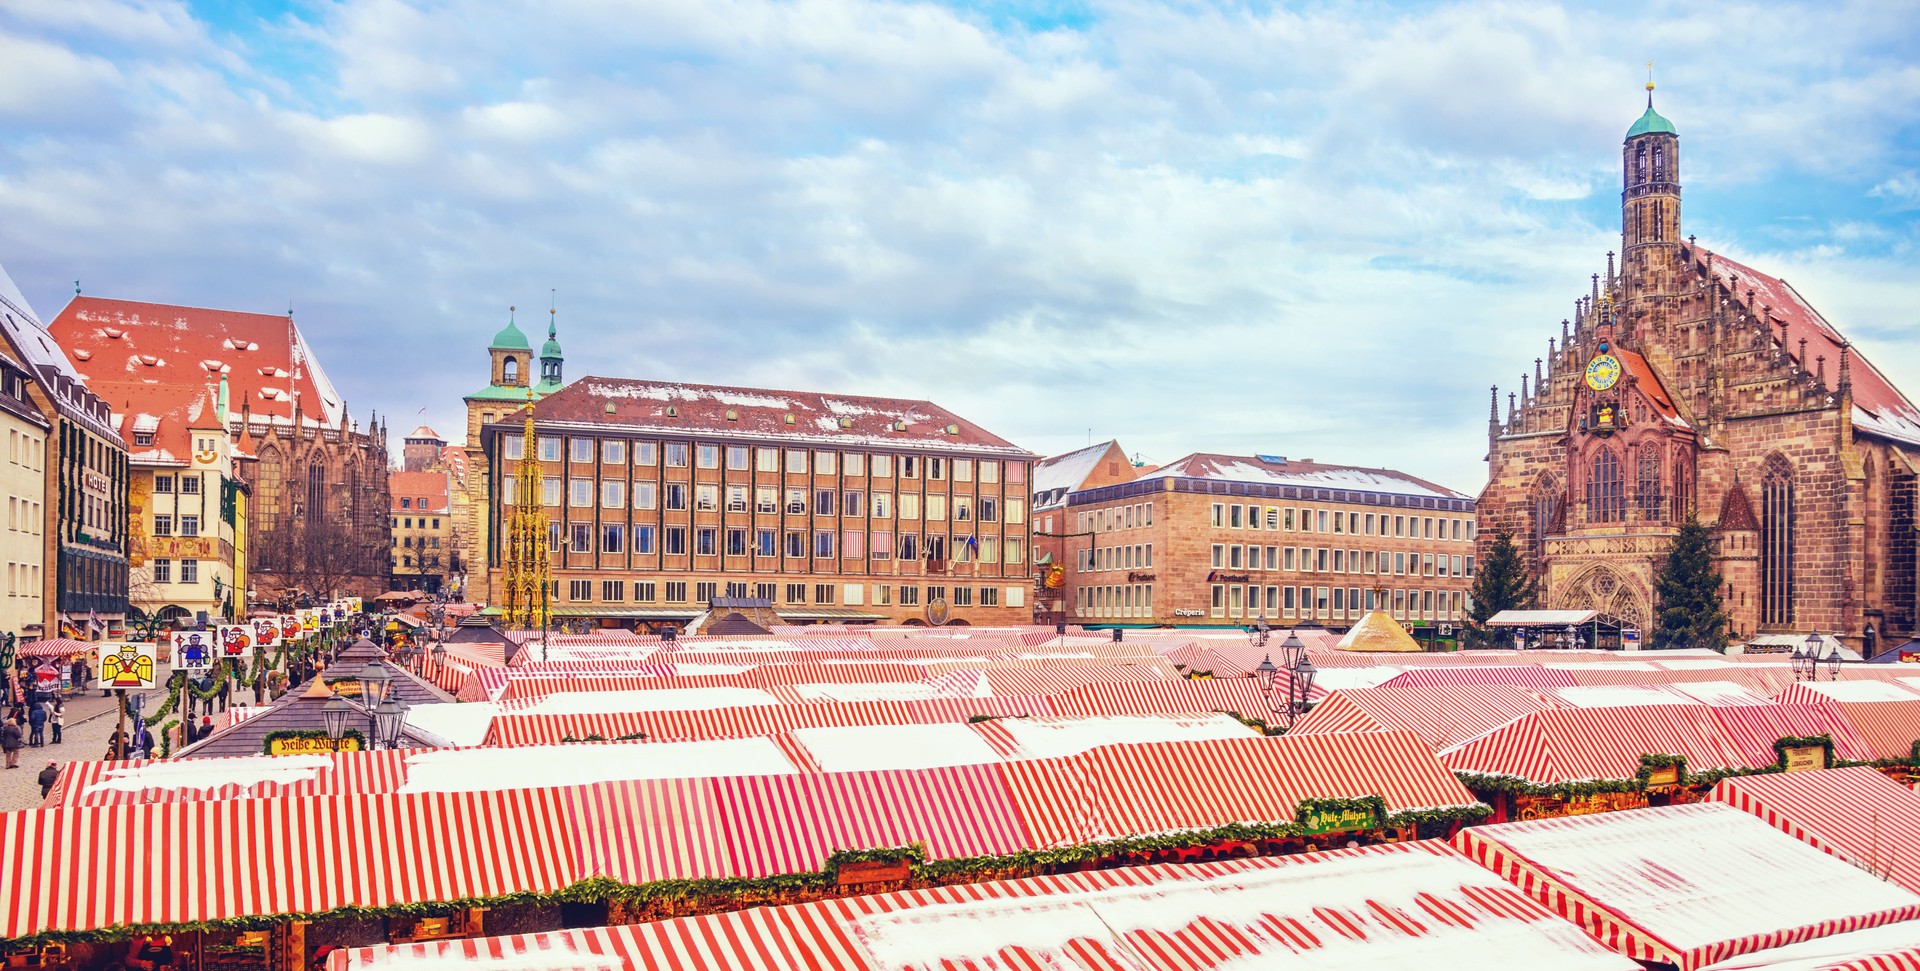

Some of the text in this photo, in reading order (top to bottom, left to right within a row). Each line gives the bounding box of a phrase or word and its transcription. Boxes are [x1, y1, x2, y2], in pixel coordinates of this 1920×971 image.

[86, 473, 109, 493] HOTEL
[1220, 574, 1249, 583] Postbank
[1175, 608, 1206, 617] Crêperie
[281, 738, 310, 751] Heiße
